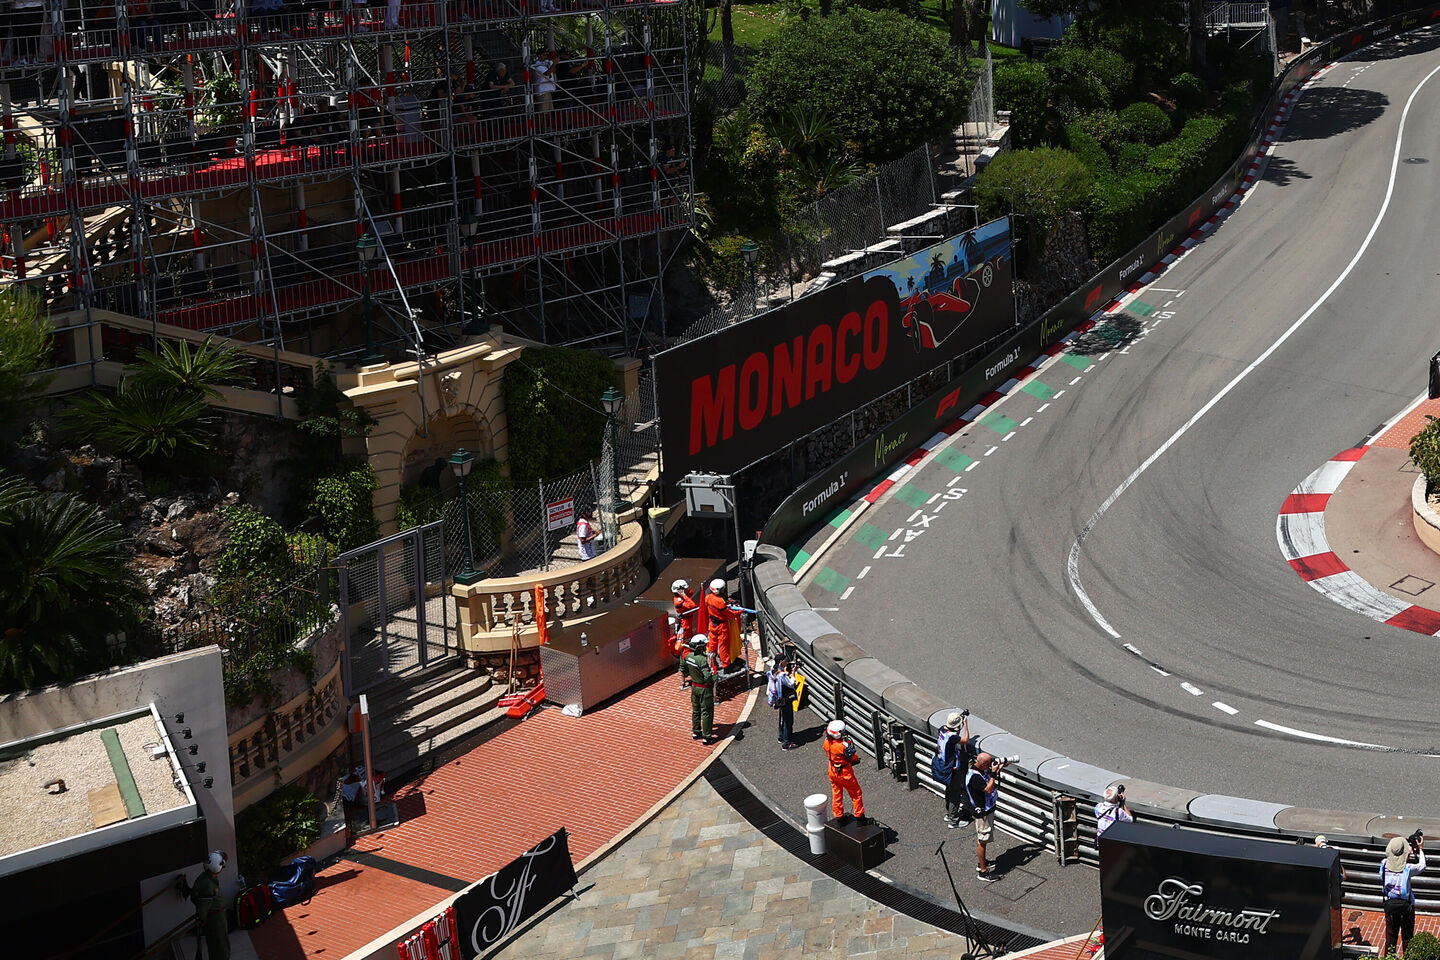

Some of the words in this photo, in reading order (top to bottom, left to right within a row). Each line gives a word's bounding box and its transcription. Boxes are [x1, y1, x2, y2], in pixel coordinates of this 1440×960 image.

[689, 300, 889, 456] MONACO
[985, 353, 1014, 381] Formula
[874, 431, 908, 467] Monaco
[803, 480, 839, 517] Formula
[1144, 878, 1280, 934] Fairmont
[1174, 923, 1211, 939] MONTE
[1216, 930, 1250, 944] CARLO
